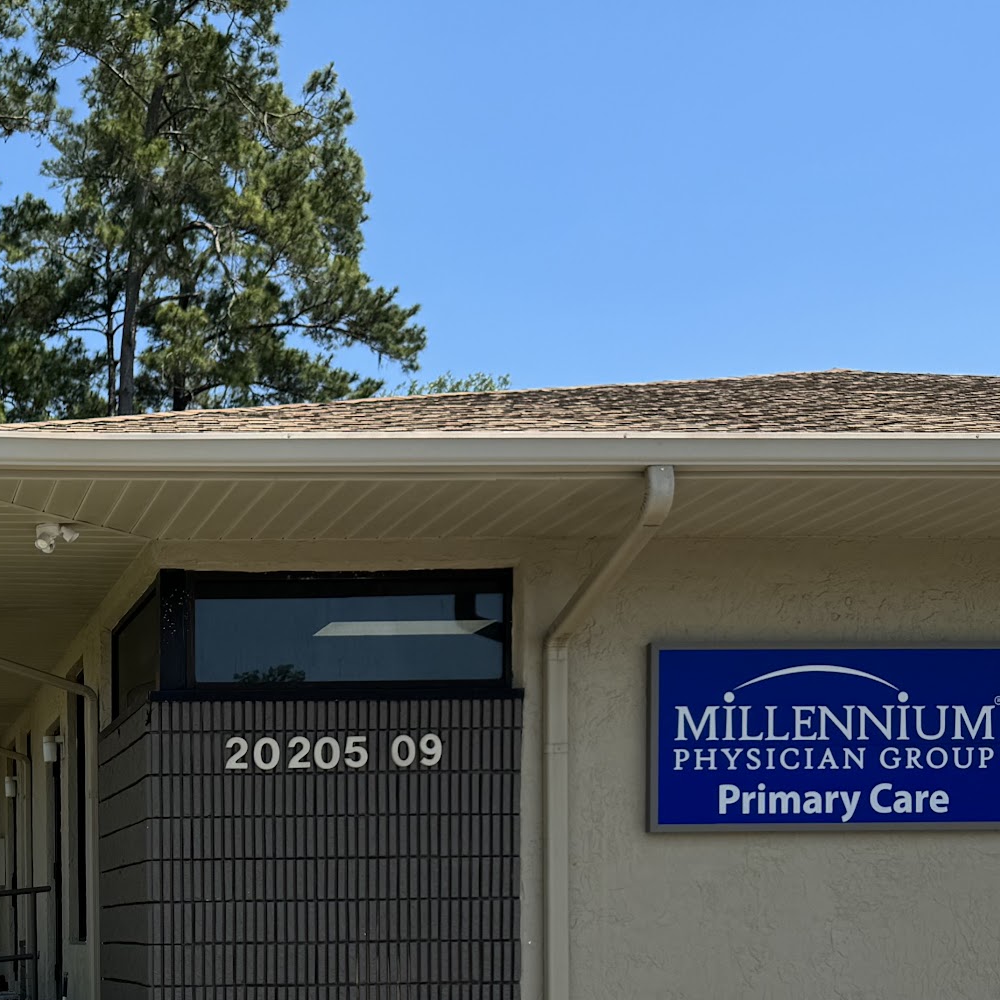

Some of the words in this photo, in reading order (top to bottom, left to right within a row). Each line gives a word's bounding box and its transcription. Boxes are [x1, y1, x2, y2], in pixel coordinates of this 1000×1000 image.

[673, 691, 996, 741] MILLENNIUM
[391, 733, 443, 767] 09
[673, 747, 865, 771] PHYSICIAN
[879, 747, 995, 770] GROUP
[718, 783, 861, 823] Primary
[869, 783, 950, 814] Care
